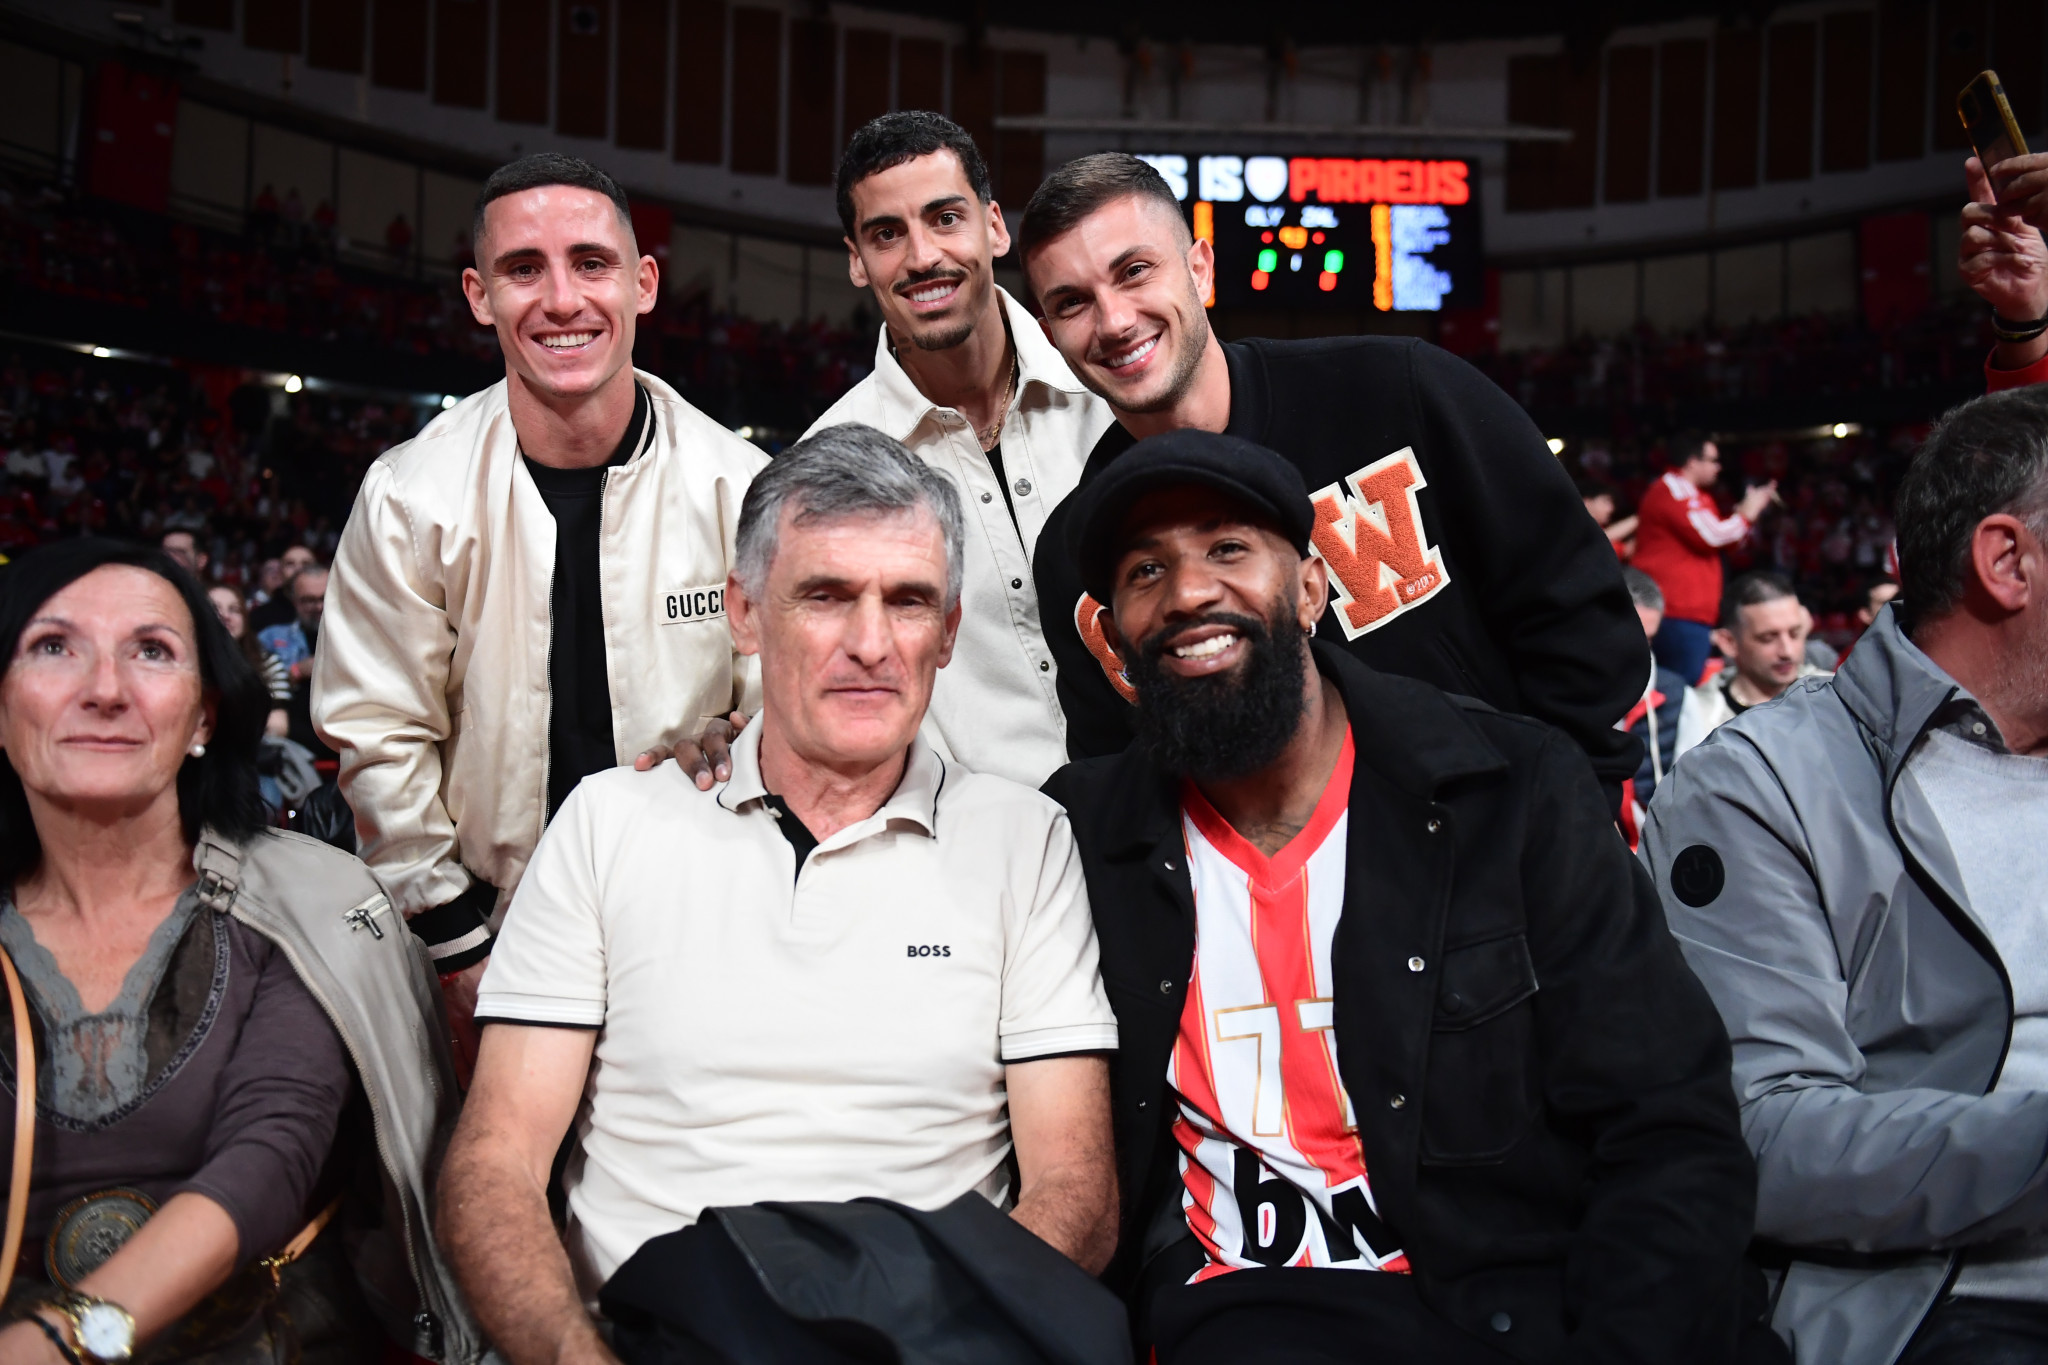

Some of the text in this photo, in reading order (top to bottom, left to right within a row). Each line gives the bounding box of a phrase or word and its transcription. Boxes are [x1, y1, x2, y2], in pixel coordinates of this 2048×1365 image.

[1199, 156, 1244, 202] IS
[1289, 158, 1470, 205] PIRAEUS
[907, 944, 952, 958] BOSS
